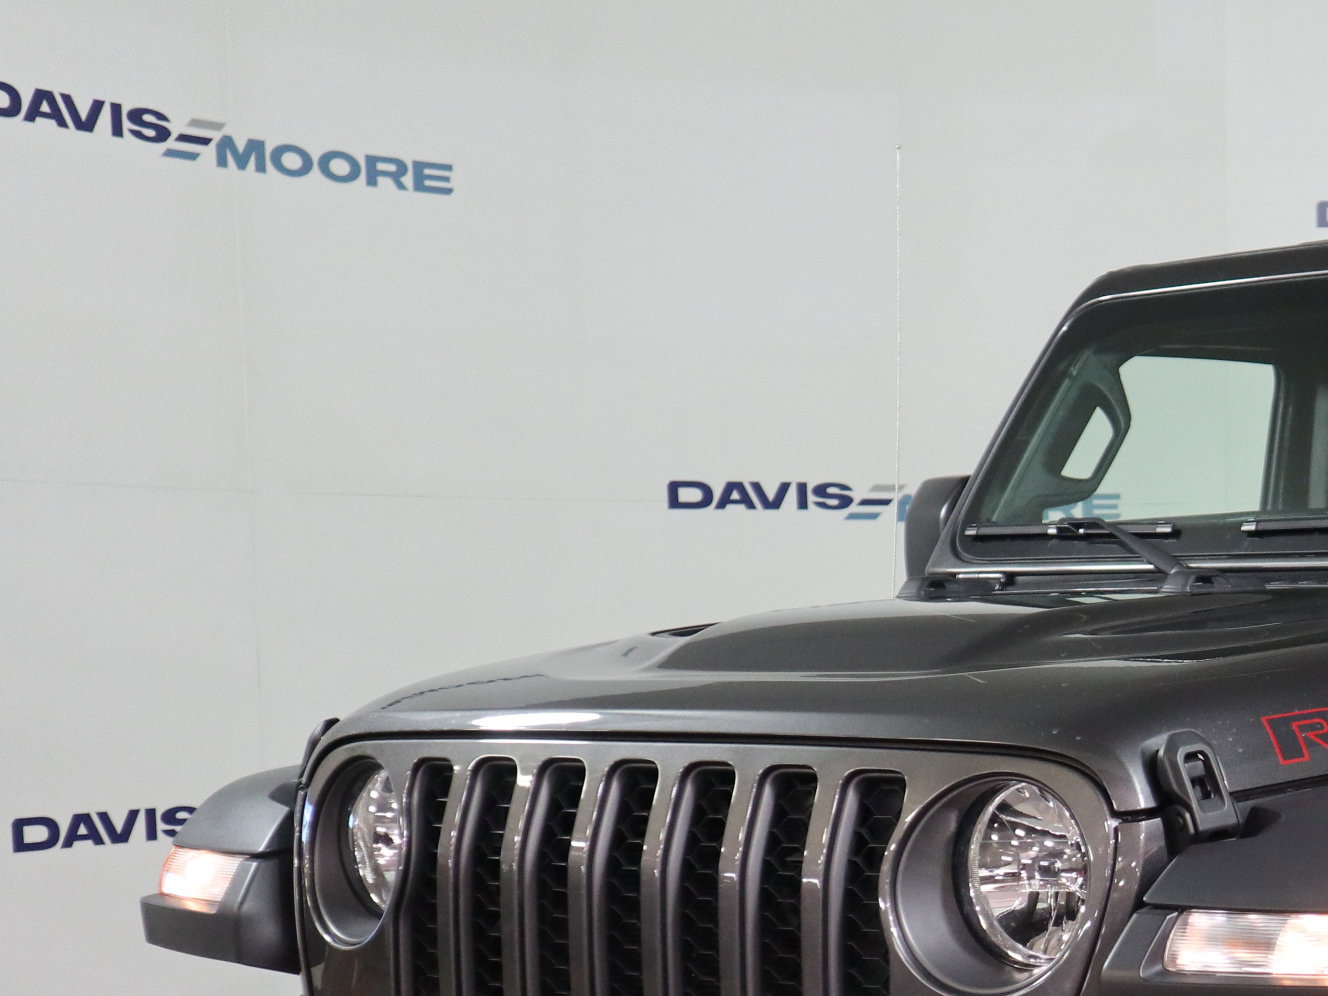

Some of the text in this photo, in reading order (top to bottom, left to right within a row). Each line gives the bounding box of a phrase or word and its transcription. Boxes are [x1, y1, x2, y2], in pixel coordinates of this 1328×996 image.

[215, 134, 455, 196] MOORE
[667, 480, 853, 511] DAVIS
[11, 805, 198, 853] DAVIS
